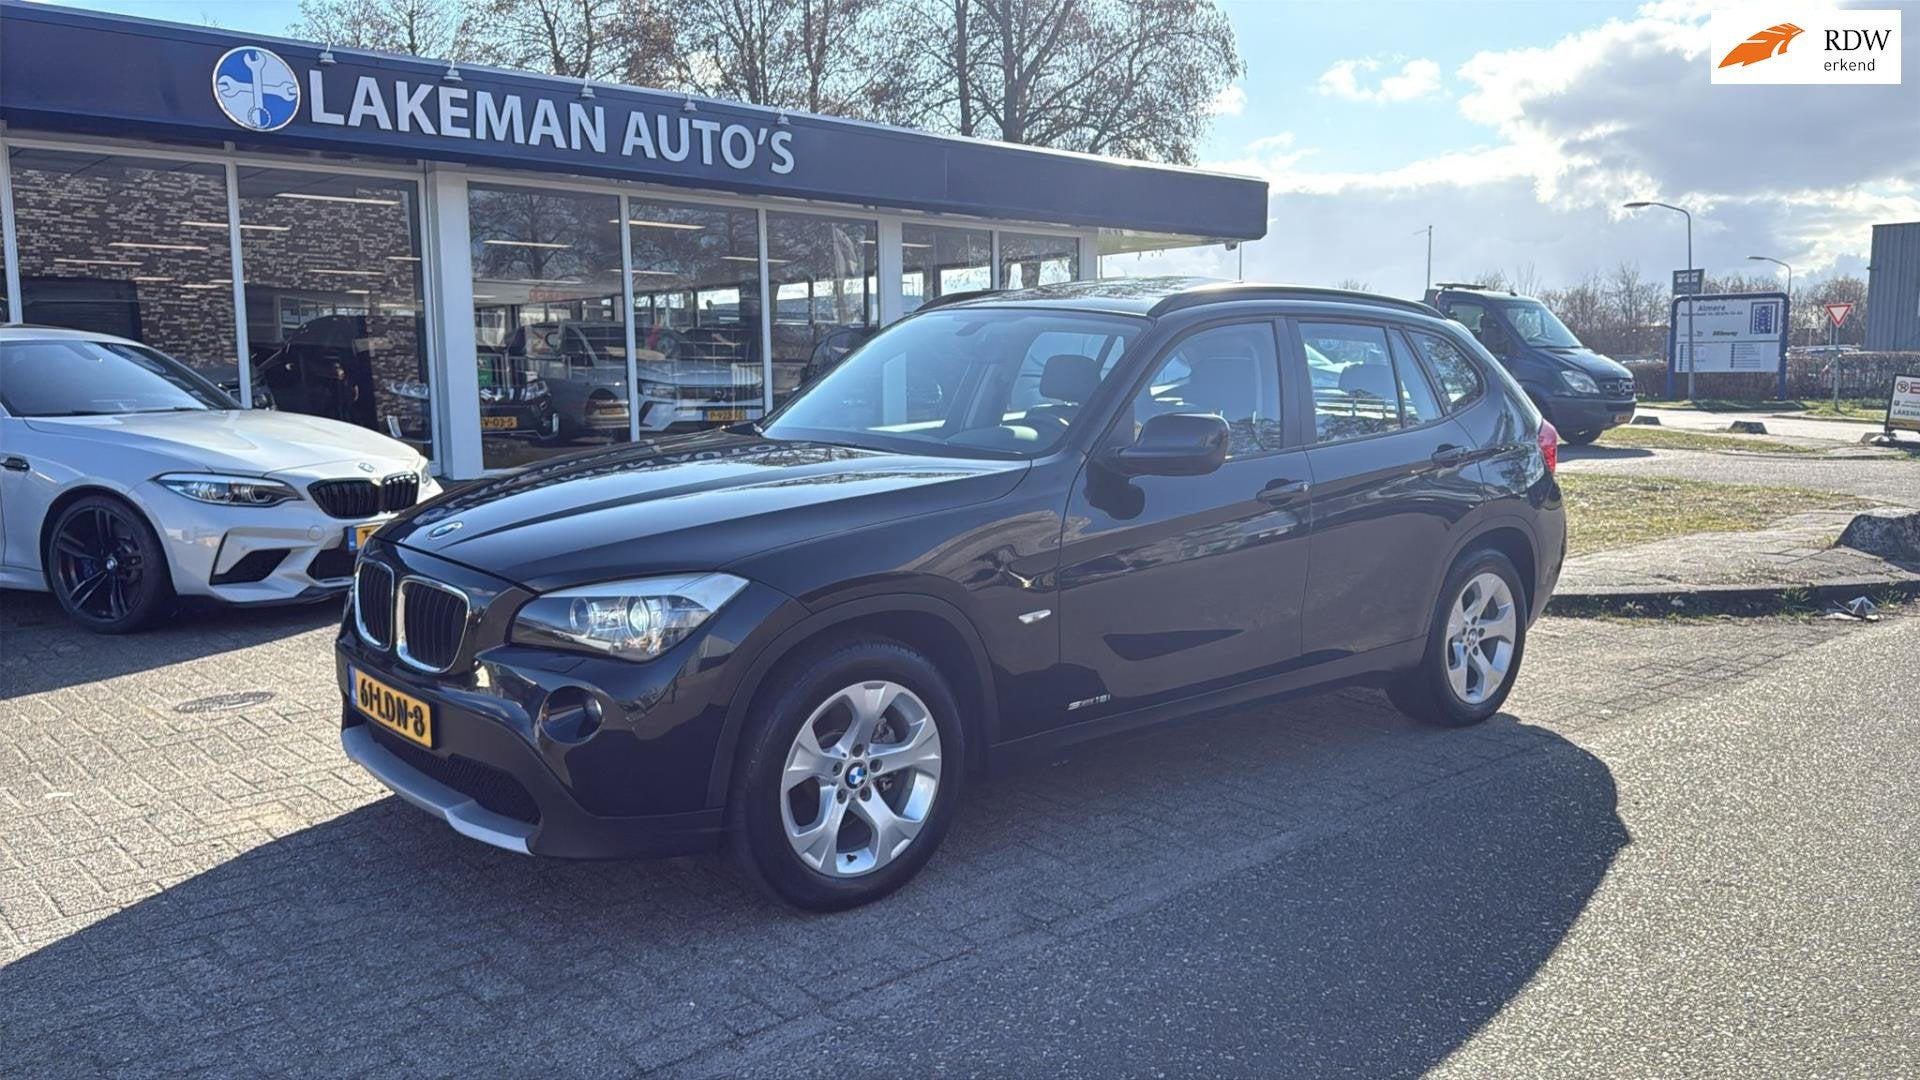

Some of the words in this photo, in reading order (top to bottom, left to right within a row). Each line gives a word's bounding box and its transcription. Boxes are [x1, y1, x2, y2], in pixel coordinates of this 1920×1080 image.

[308, 69, 606, 153] LAKEMAN
[621, 110, 795, 175] AUTO'S
[360, 678, 425, 737] 61-LDN-8
